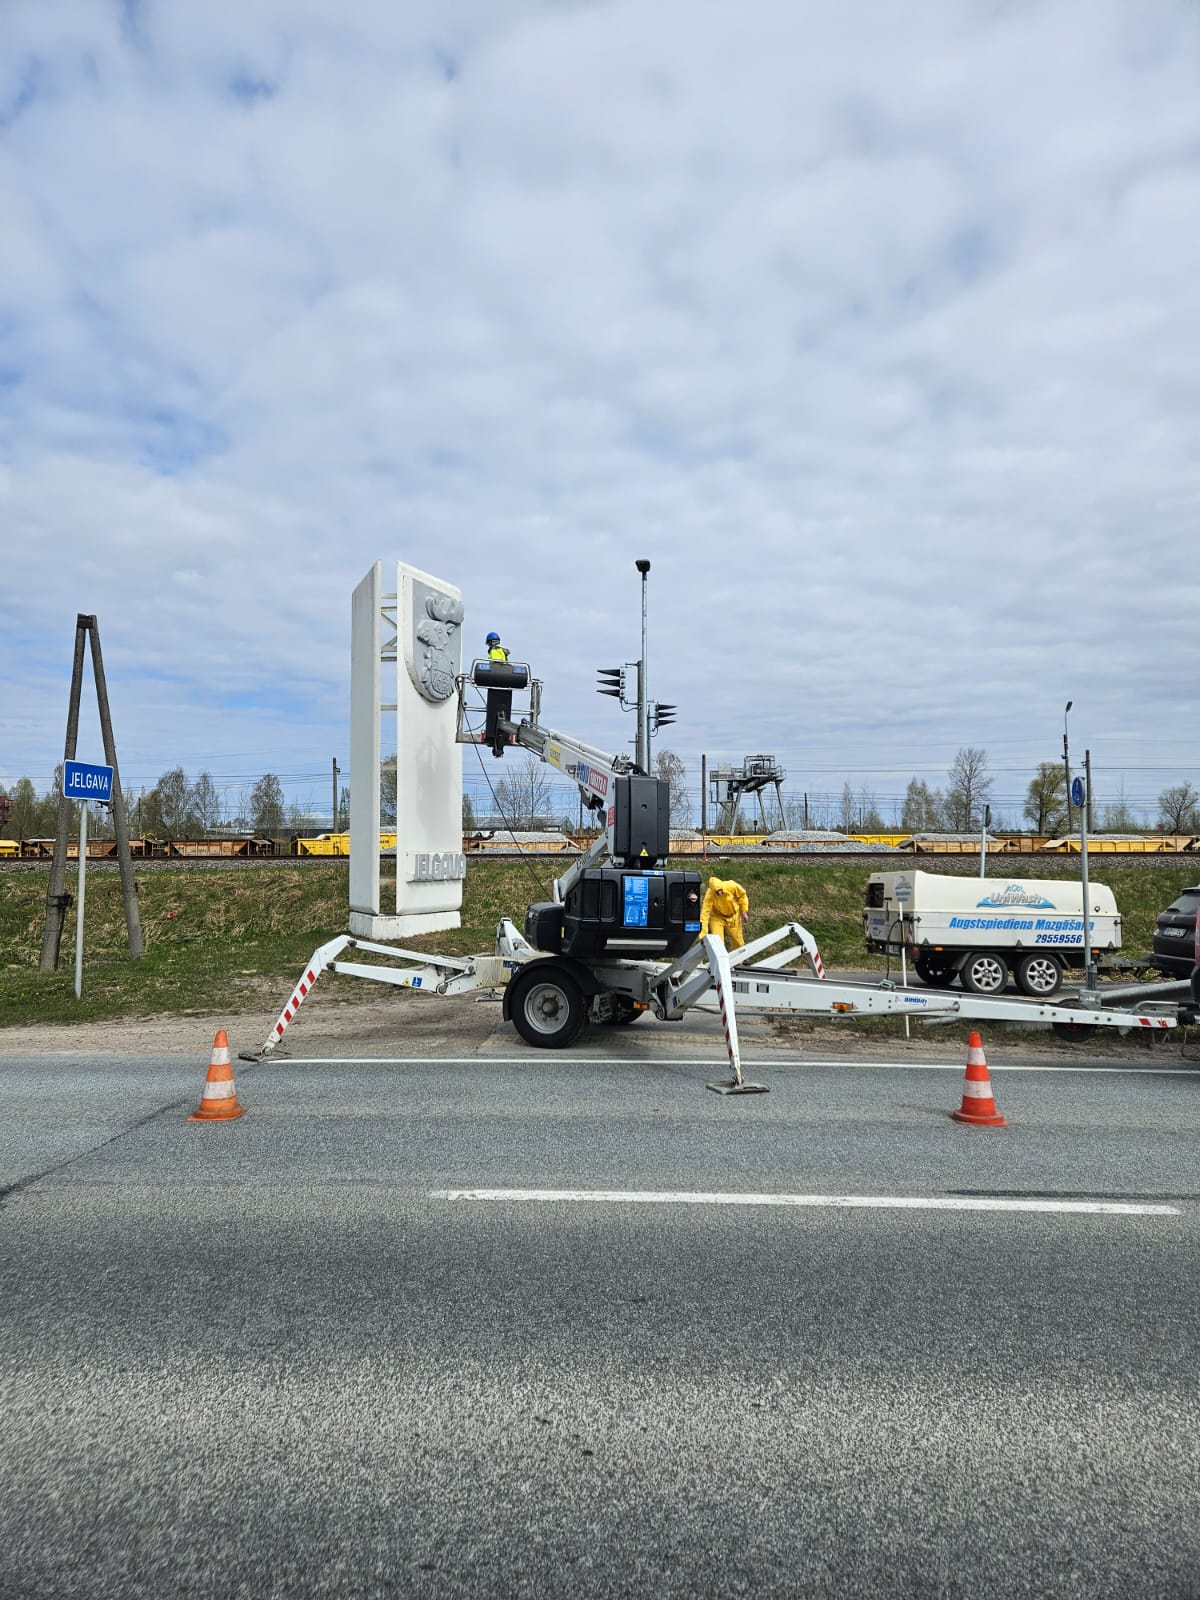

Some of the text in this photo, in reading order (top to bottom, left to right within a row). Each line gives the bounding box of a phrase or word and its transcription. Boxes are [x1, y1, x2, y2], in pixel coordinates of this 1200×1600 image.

[69, 771, 108, 791] JELGAVA
[990, 893, 1042, 904] UniWash
[949, 917, 1033, 932] Augstspiediena
[1035, 934, 1082, 943] 29559556
